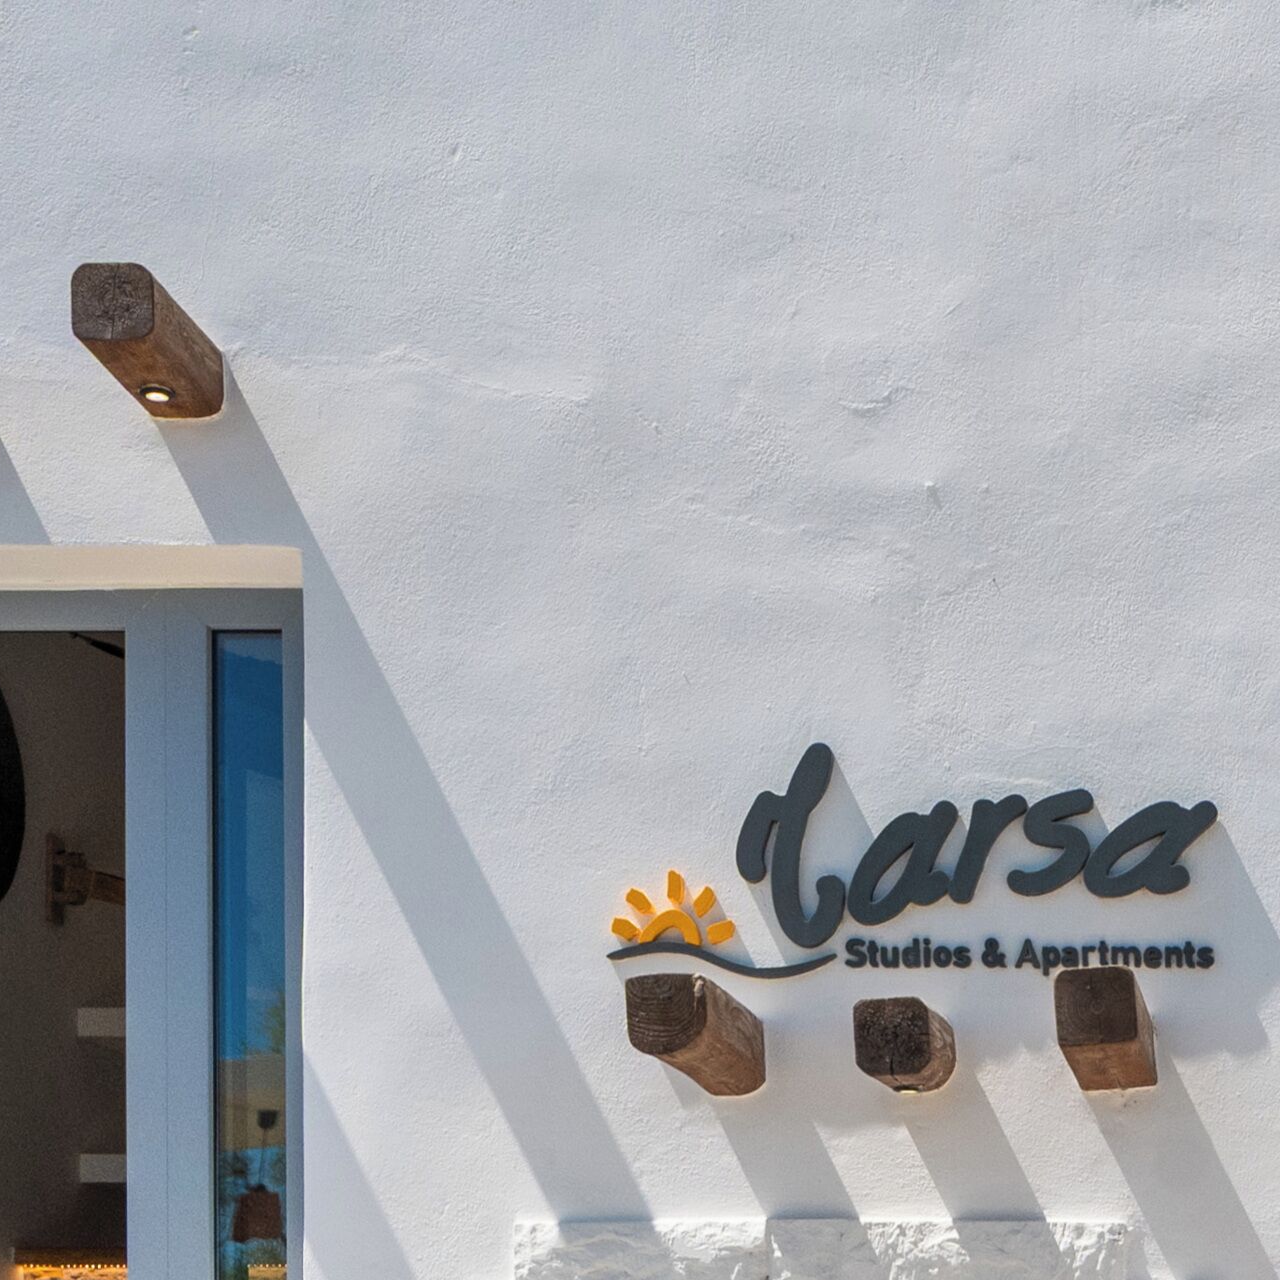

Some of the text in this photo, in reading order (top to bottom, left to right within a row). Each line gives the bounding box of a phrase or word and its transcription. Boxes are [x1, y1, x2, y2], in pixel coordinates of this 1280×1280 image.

[845, 938, 1215, 975] Studios & Apartments
